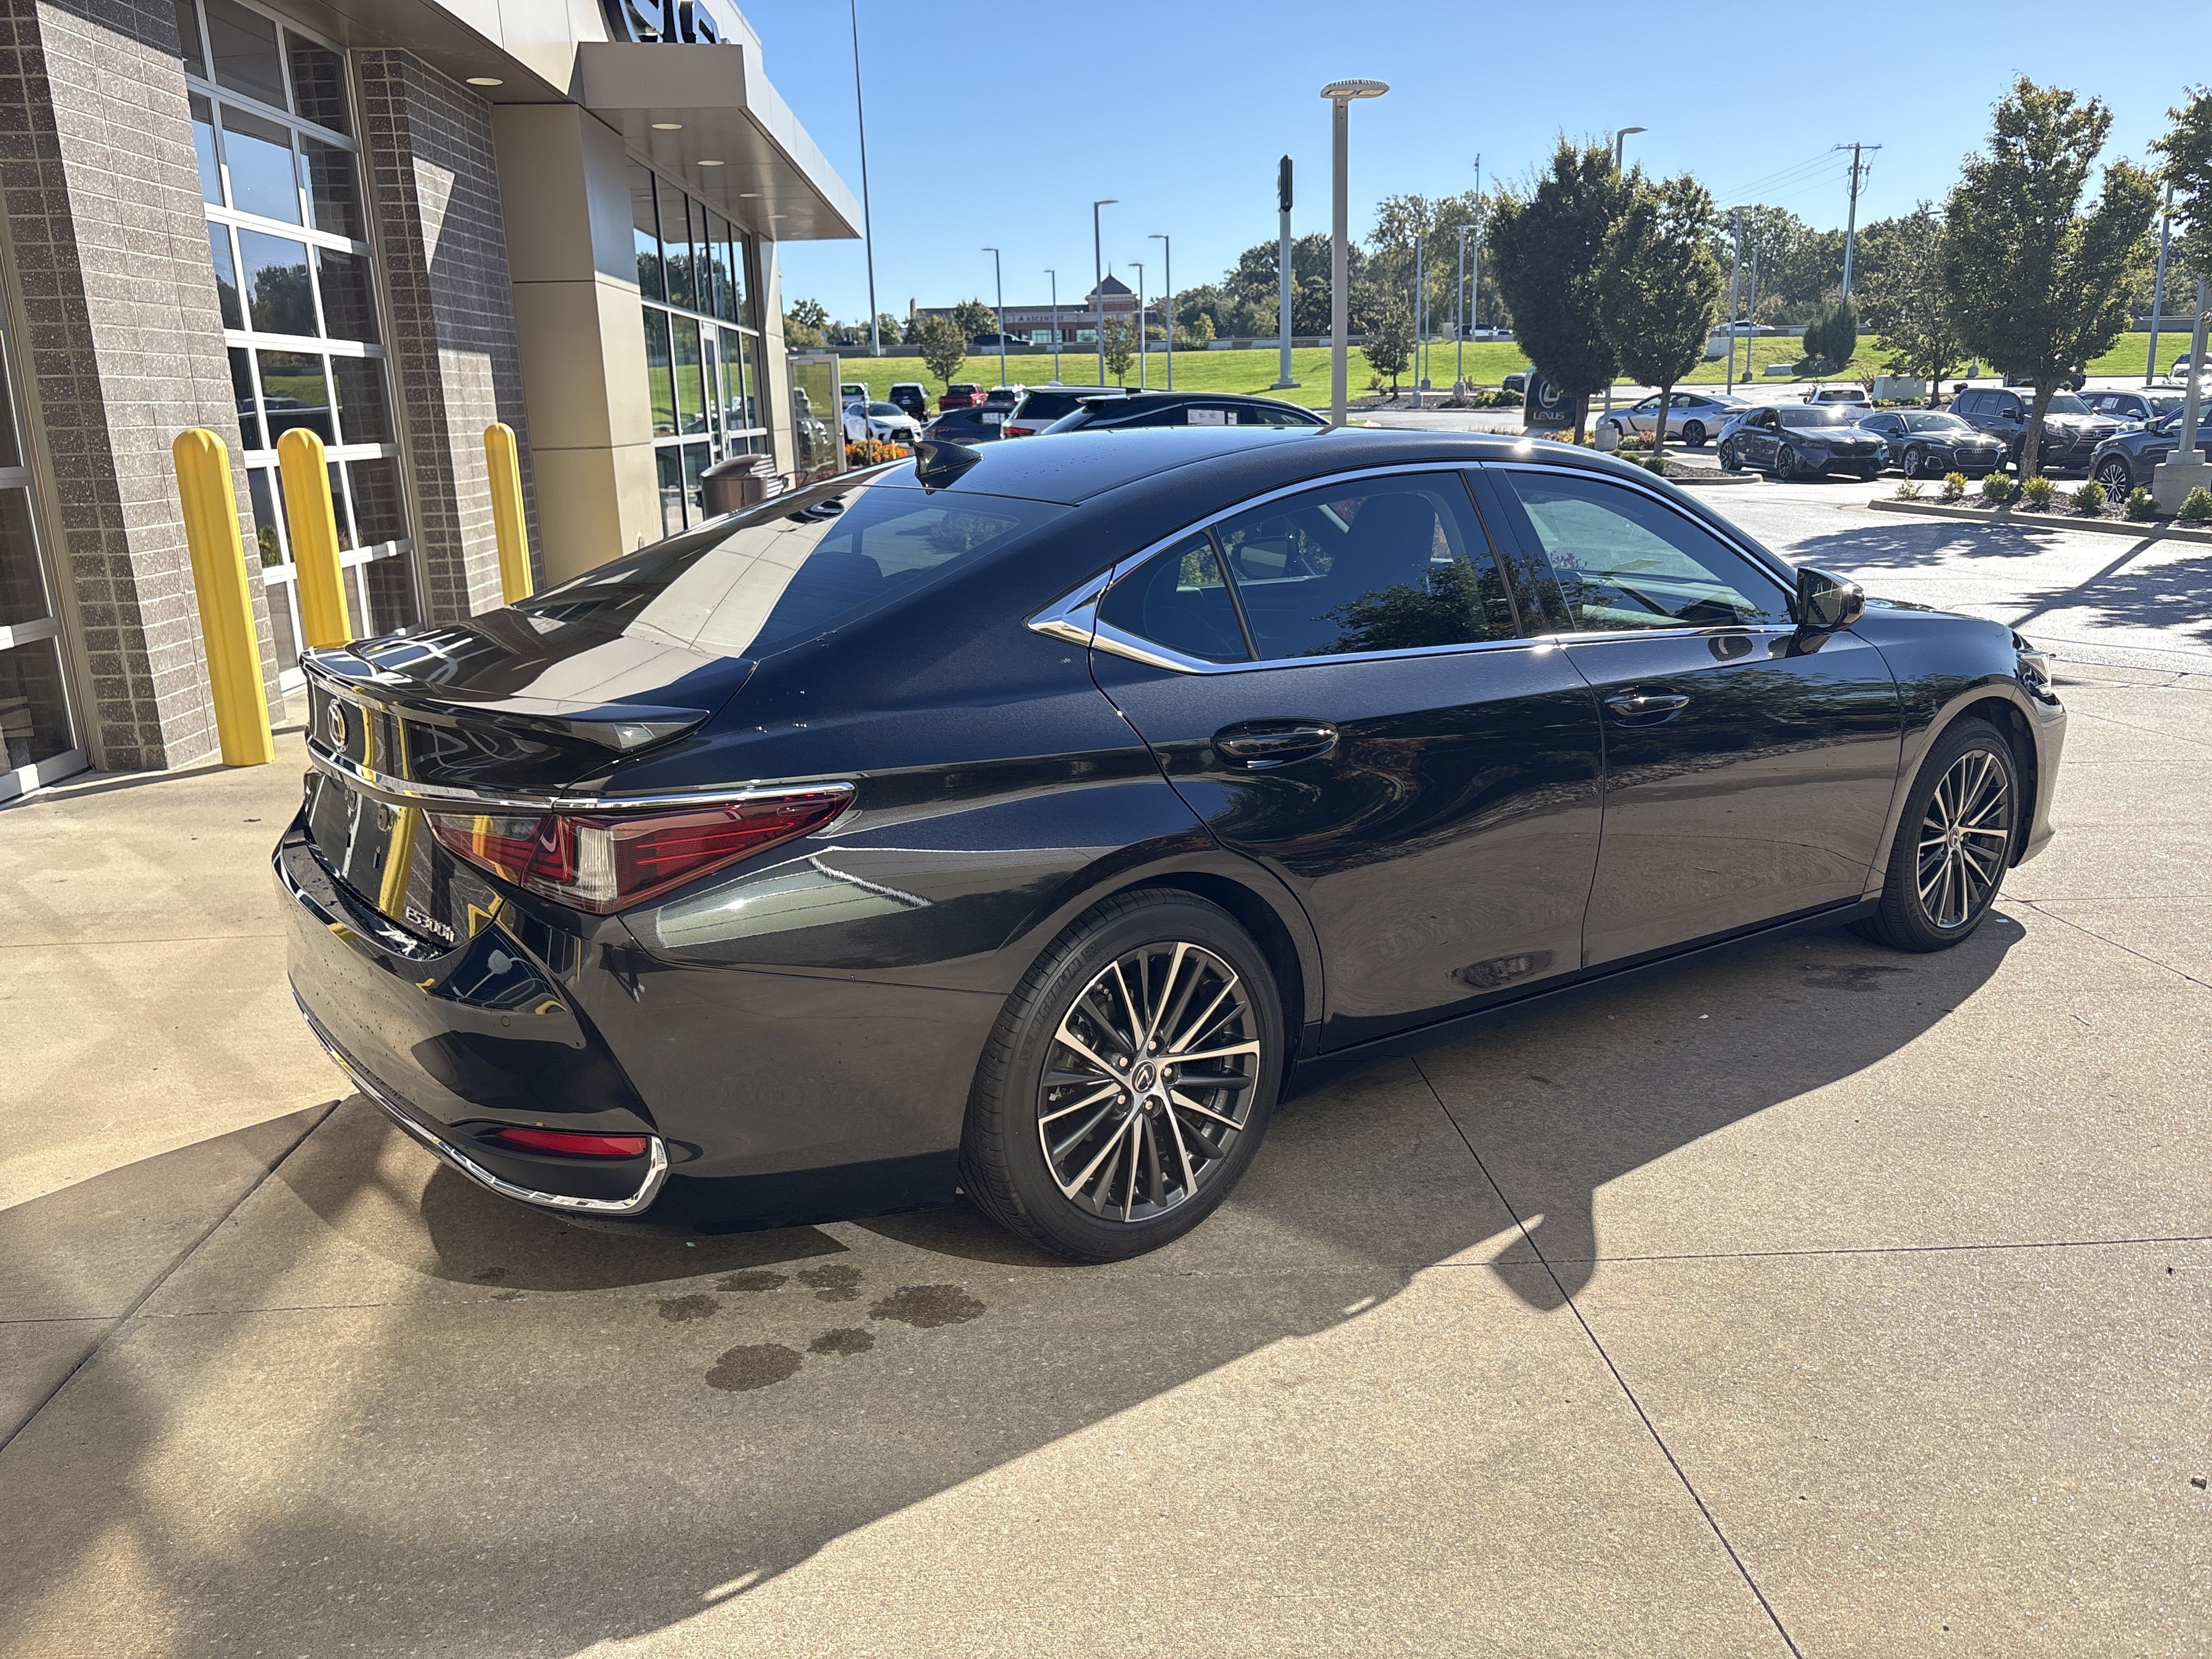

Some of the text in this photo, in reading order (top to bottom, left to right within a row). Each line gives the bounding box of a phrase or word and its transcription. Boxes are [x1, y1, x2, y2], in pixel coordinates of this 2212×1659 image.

[1533, 411, 1565, 420] LEXUS
[406, 906, 455, 943] ES300h
[1029, 958, 1081, 1038] MICHELIN
